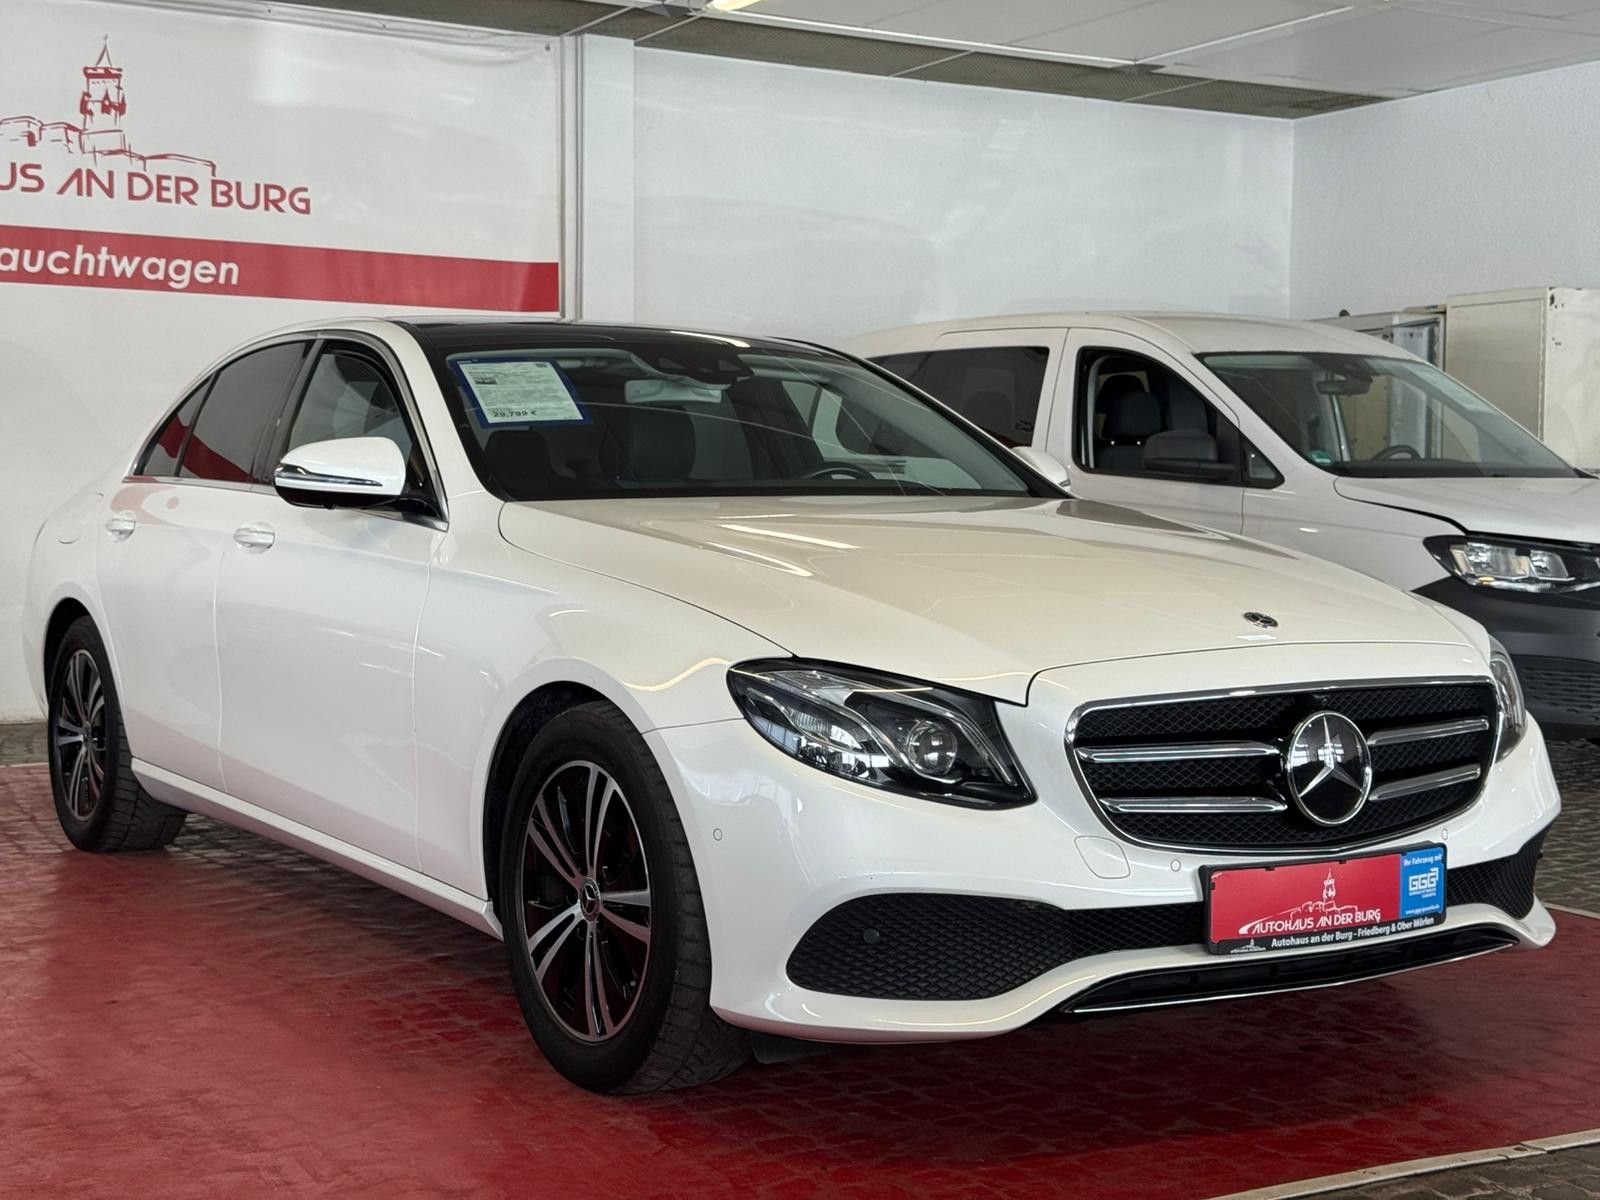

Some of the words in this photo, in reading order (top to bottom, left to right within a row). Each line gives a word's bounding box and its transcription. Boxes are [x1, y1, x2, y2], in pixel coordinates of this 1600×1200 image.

[56, 168, 115, 199] AN
[127, 171, 200, 206] DER
[210, 178, 312, 215] BURG
[0, 244, 240, 289] auchtwagen
[1409, 868, 1438, 891] GGG
[1251, 917, 1314, 935] AUTOHAUS
[1316, 915, 1332, 927] AN
[1333, 912, 1354, 925] DER
[1355, 908, 1381, 923] BURG
[1271, 936, 1309, 948] Autohaus
[1310, 935, 1320, 943] an
[1321, 932, 1335, 942] der
[1335, 930, 1353, 941] Burg
[1357, 925, 1391, 938] Friedberg
[1391, 923, 1397, 932] &
[1397, 920, 1413, 930] Ober
[1413, 917, 1435, 928] Mörlen
